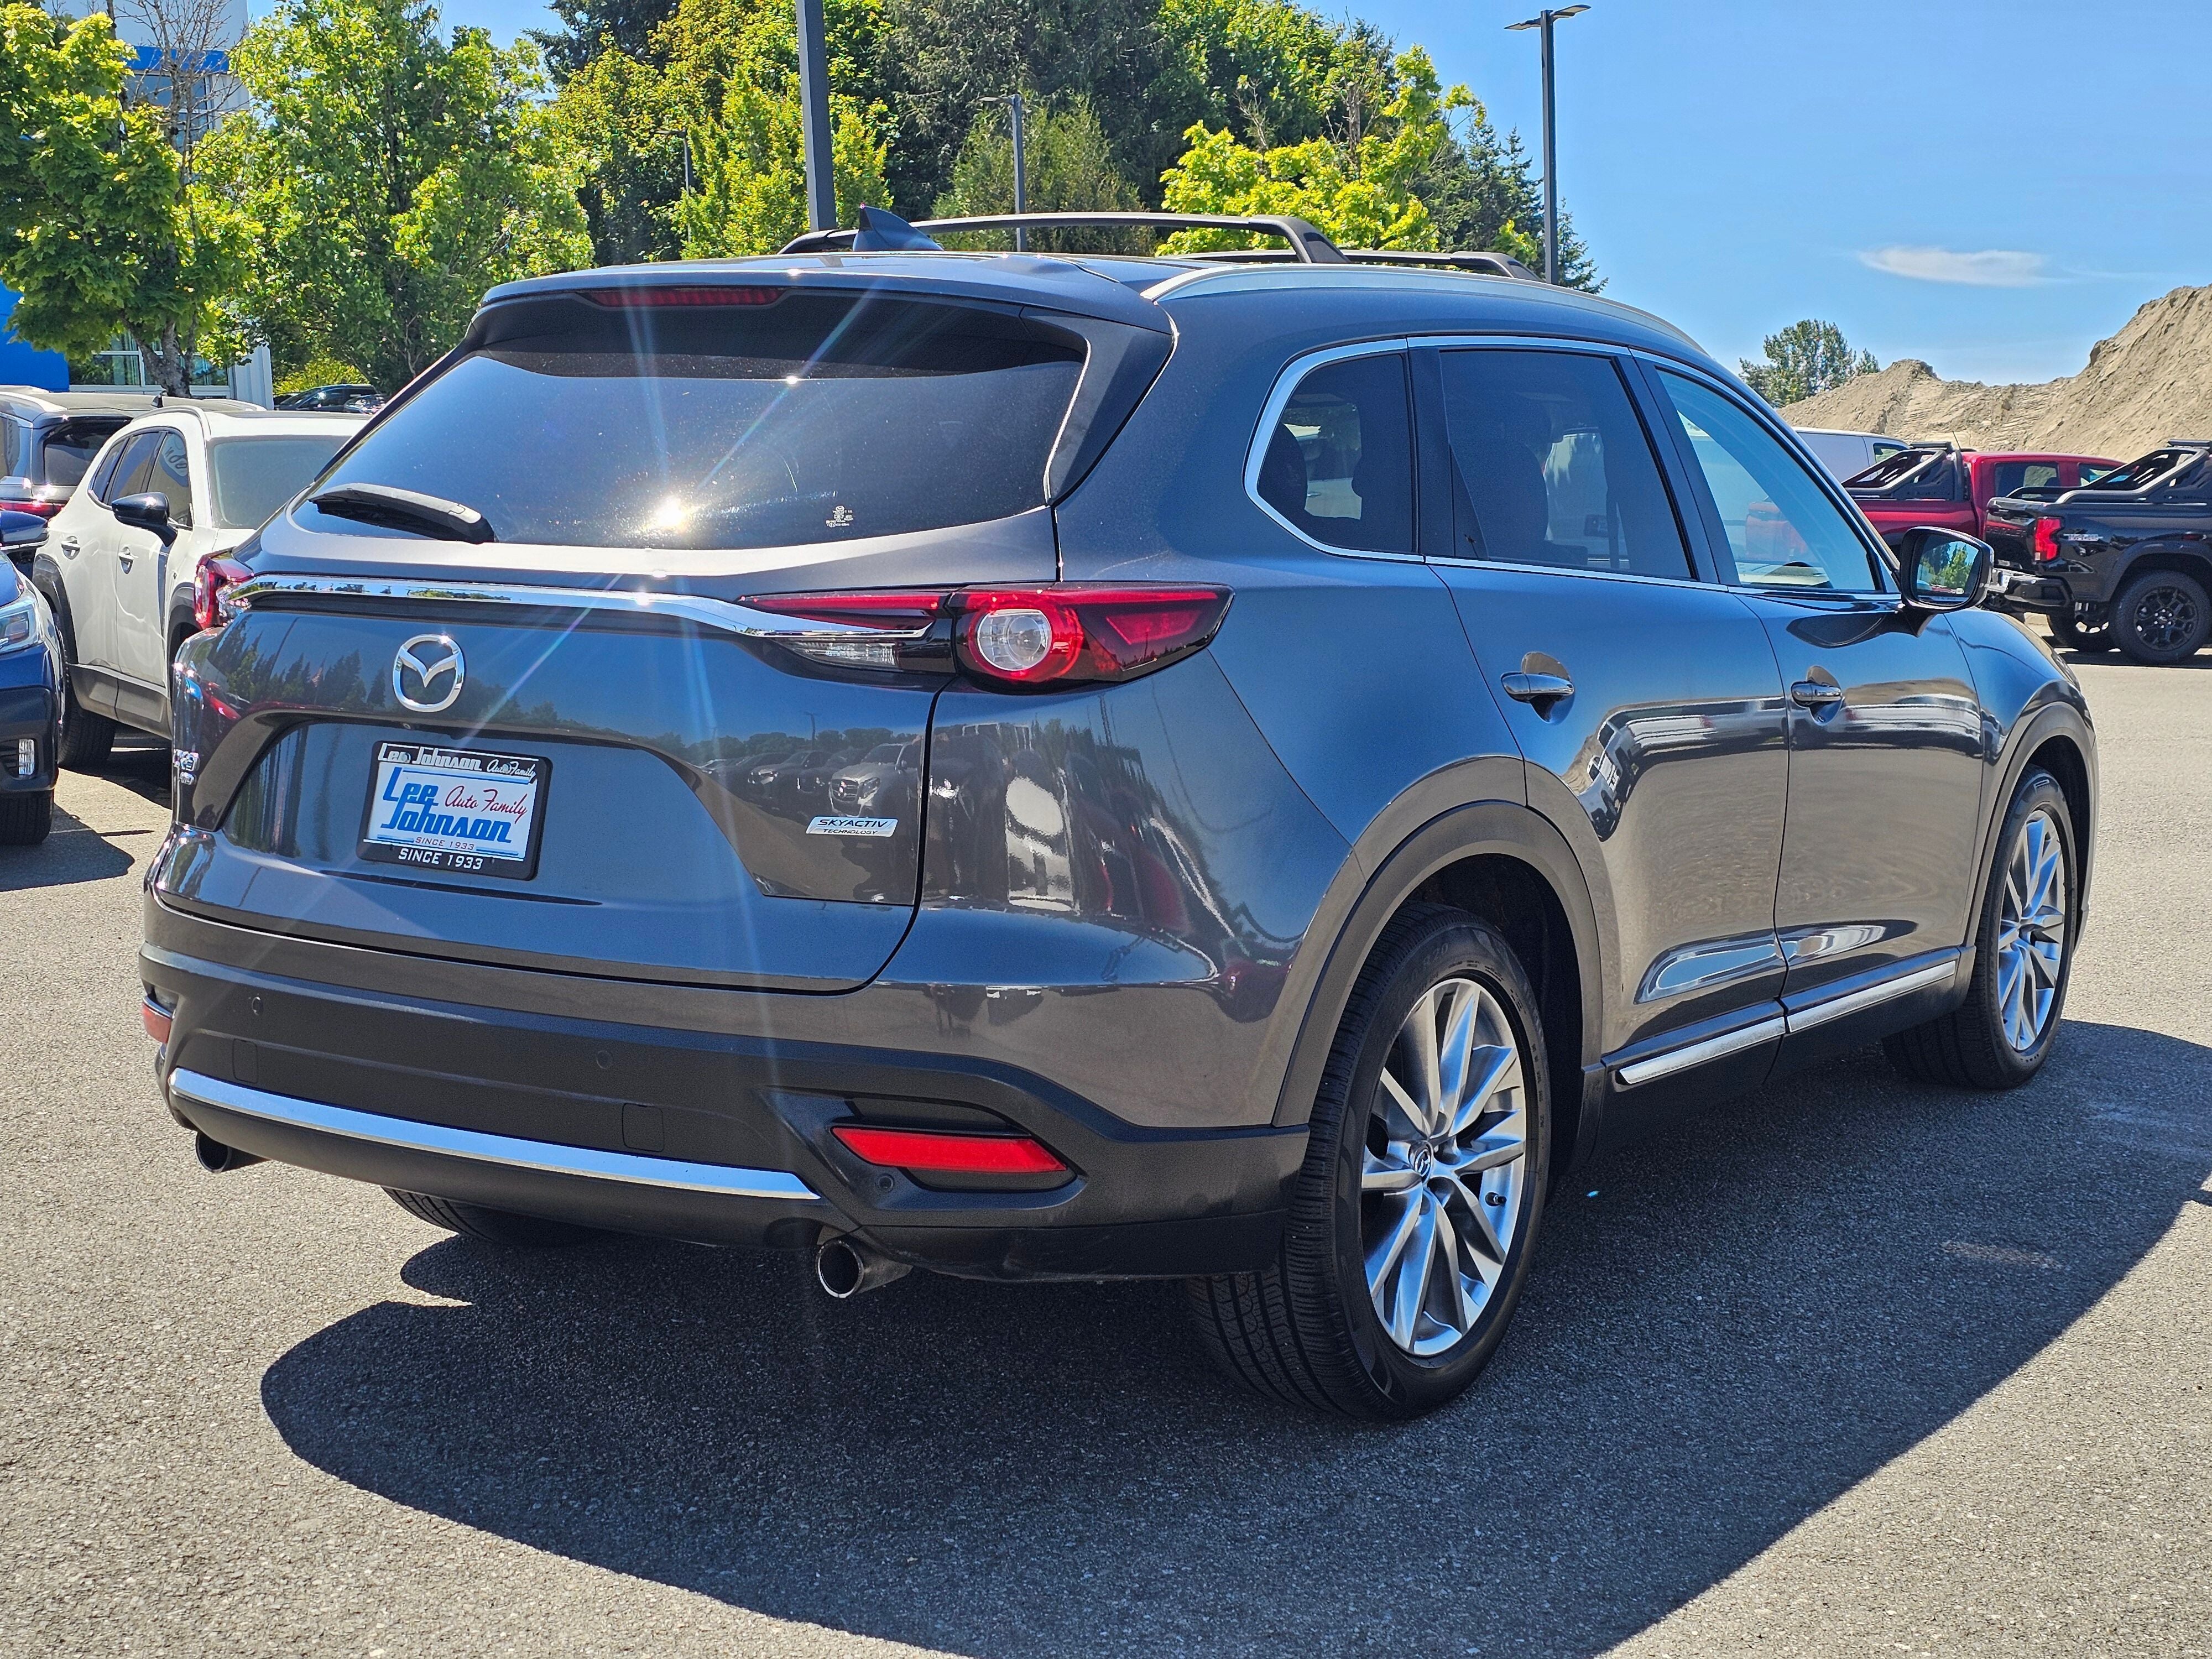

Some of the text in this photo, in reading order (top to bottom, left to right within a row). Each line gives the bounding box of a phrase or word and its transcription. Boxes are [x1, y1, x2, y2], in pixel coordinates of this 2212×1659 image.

[412, 747, 482, 771] Johnson
[487, 759, 510, 774] Aut
[510, 761, 536, 782] Family
[383, 766, 439, 806] Lee
[445, 785, 528, 824] Auto Family
[380, 802, 512, 843] Johnson
[817, 819, 889, 828] SKYACTIV
[398, 848, 483, 870] SINCE 1933
[415, 837, 474, 851] SINCE 1933
